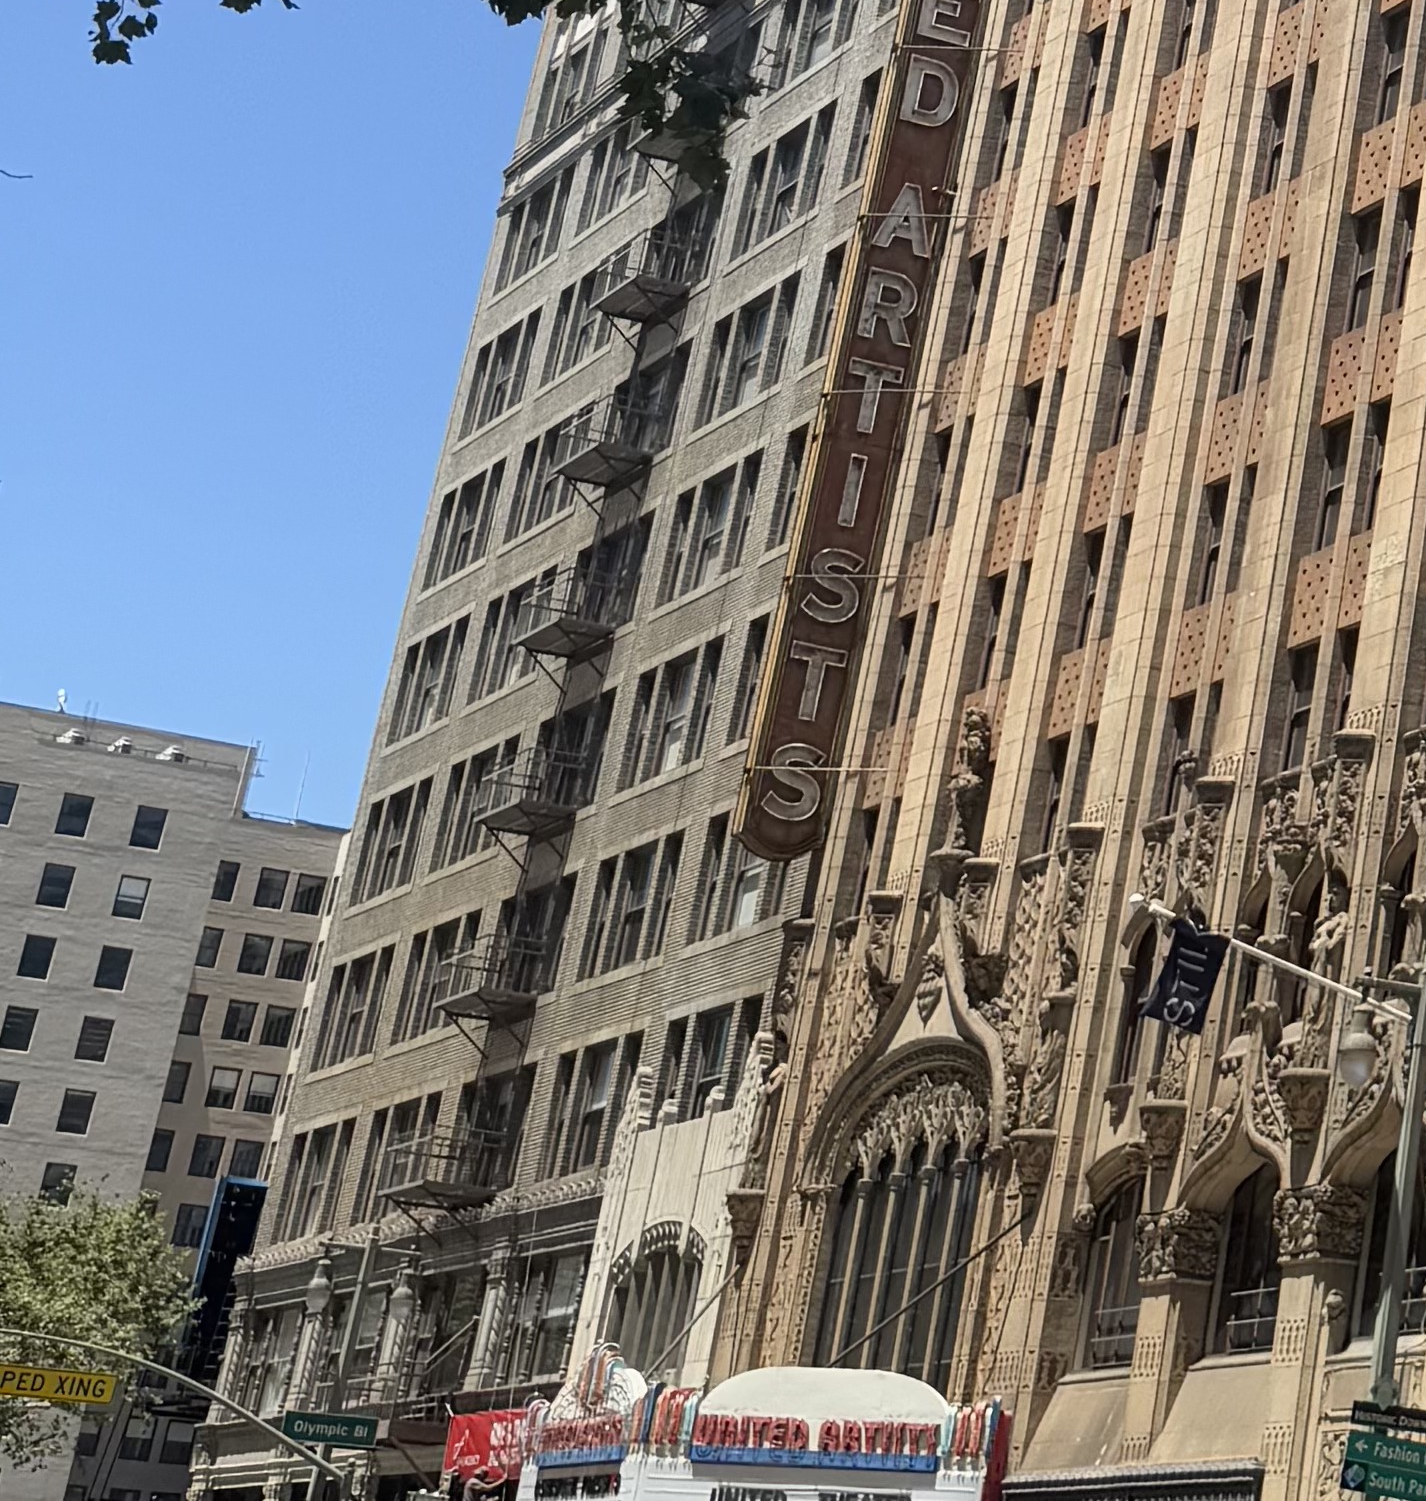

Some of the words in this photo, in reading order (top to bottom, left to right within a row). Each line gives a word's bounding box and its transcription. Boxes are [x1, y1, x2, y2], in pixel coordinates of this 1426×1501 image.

[759, 183, 931, 825] ARTISTS
[0, 1371, 45, 1391] PED
[55, 1375, 107, 1398] XING
[294, 1419, 349, 1437] Olympic
[354, 1424, 369, 1438] Bl
[693, 1414, 809, 1452] UNITED
[1373, 1441, 1420, 1463] Fashion
[1369, 1472, 1406, 1491] South
